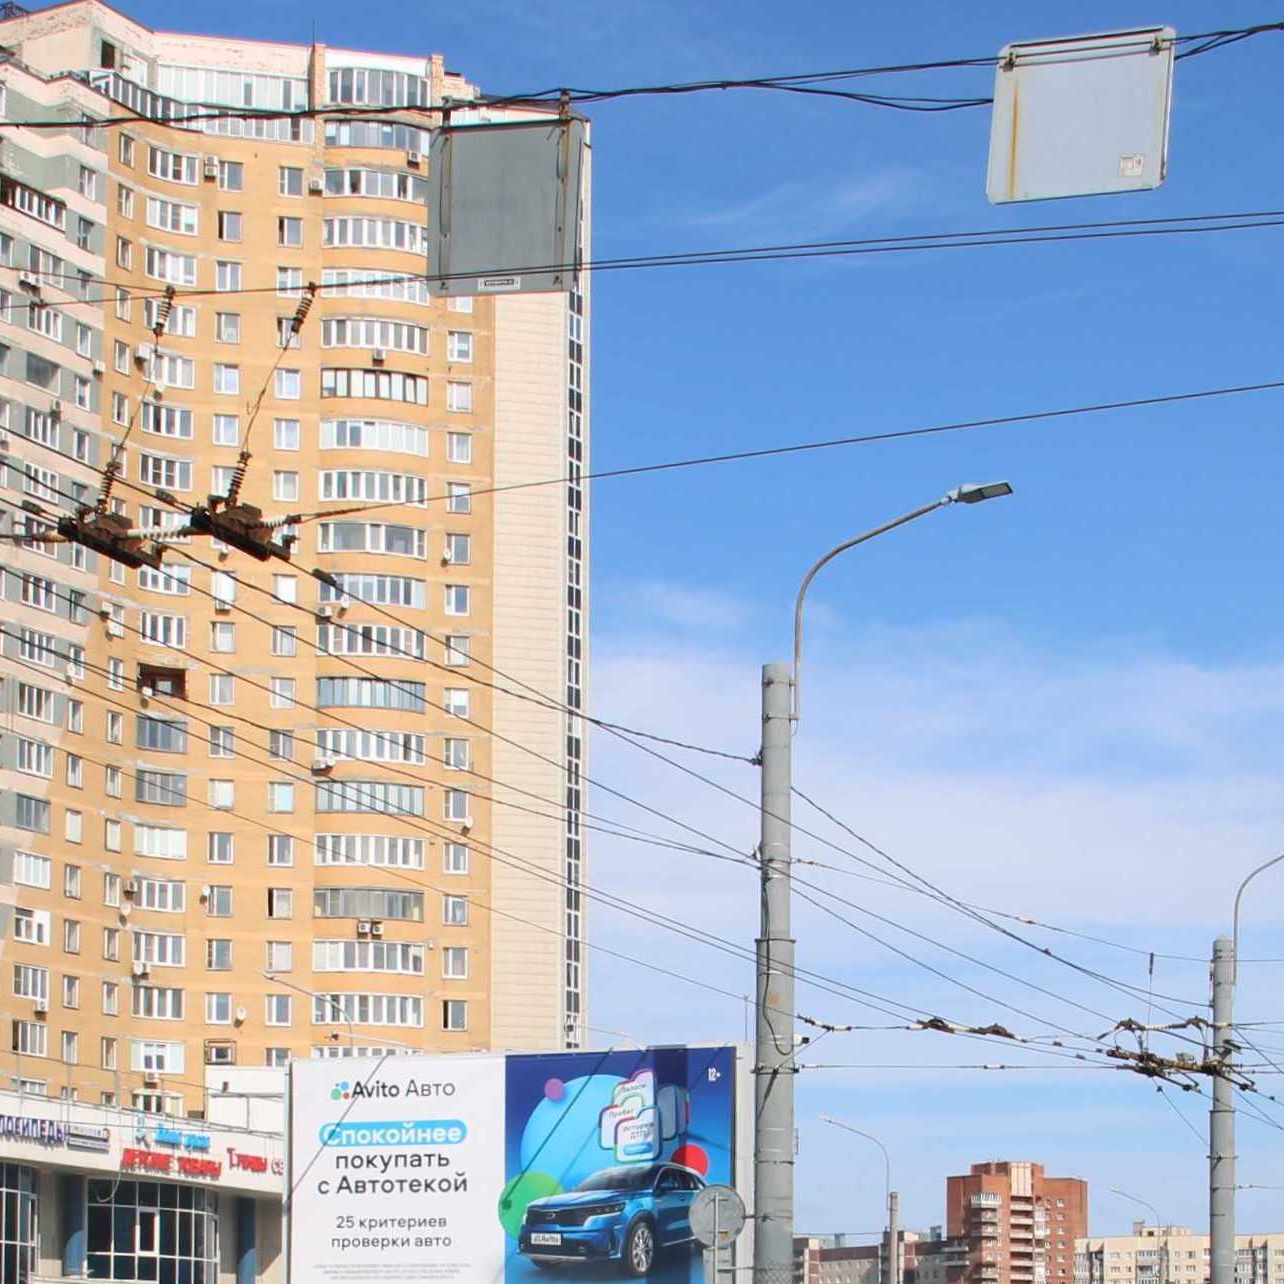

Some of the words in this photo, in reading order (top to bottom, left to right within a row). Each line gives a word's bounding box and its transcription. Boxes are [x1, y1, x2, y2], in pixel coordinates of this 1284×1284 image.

[352, 1080, 400, 1098] Avito
[406, 1079, 456, 1097] Авто
[323, 1122, 462, 1145] Спокойнее
[335, 1153, 451, 1174] покупать
[318, 1180, 330, 1194] с
[336, 1171, 468, 1195] Автотекой
[336, 1216, 355, 1229] 25
[359, 1217, 447, 1231] критериев
[331, 1236, 410, 1251] проверки
[414, 1236, 452, 1248] авто
